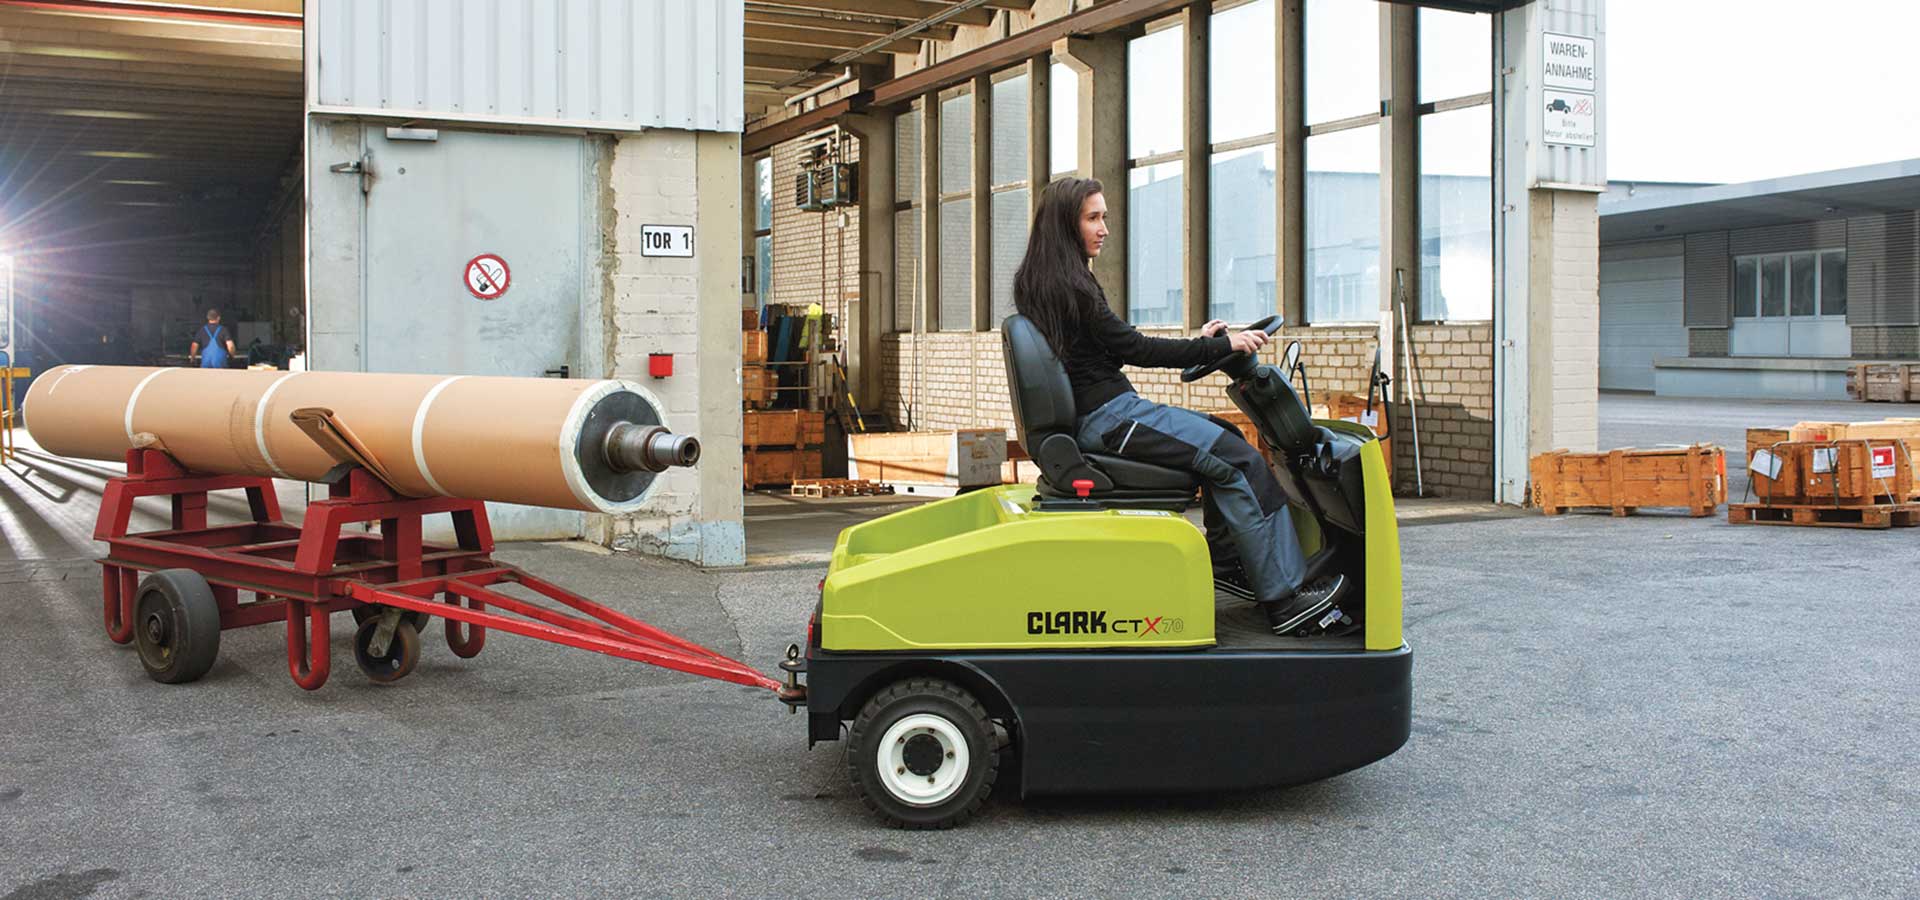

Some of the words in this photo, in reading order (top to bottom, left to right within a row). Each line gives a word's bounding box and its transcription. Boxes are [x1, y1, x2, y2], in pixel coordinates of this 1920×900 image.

[1550, 41, 1588, 58] WAREN-
[1545, 62, 1593, 81] ANNAHME
[644, 231, 671, 249] TOR
[682, 232, 689, 250] 1
[1027, 611, 1107, 634] CLARK
